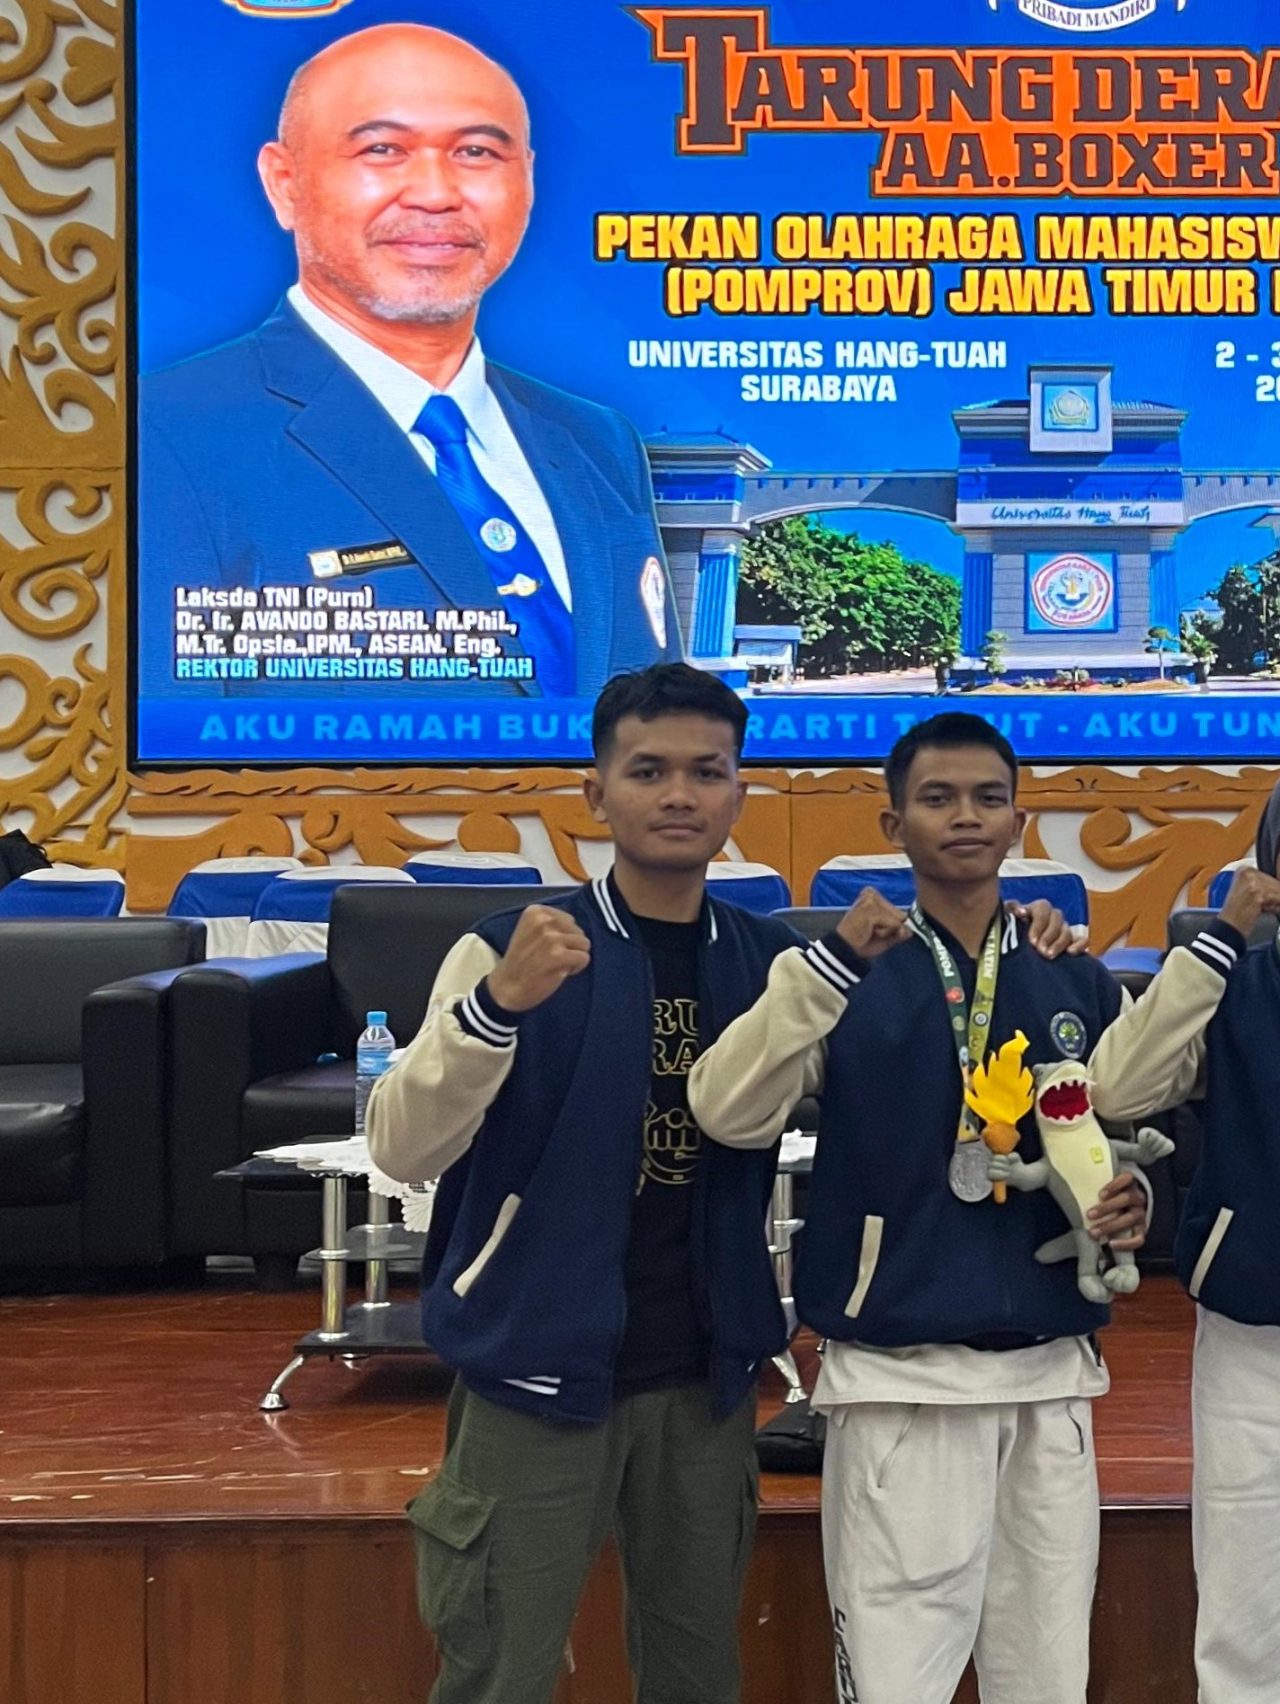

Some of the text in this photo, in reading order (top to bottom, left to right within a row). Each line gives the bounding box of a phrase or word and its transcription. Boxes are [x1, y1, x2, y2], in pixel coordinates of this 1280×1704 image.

[1023, 0, 1081, 27] PRIBADI
[658, 12, 1056, 148] TARUNG
[882, 131, 1275, 189] AA.BOXER
[598, 215, 757, 259] PEKAN
[776, 216, 1022, 259] OLAHRAGA
[667, 267, 931, 315] (POMPROV)
[949, 269, 1091, 313] JAWA
[1106, 269, 1255, 313] TIMUR
[629, 340, 1006, 368] UNIVERSITAS HANG-TUAH
[1216, 341, 1235, 368] 2
[741, 375, 896, 402] SURABAYA
[176, 586, 373, 608] Laksda TNI (Purn)
[176, 610, 206, 631] Dr.
[212, 610, 235, 631] Ir.
[240, 610, 328, 631] AVANDO
[176, 633, 227, 655] M.Tr.
[454, 633, 501, 658] Eng.
[176, 657, 533, 678] REKTOR UNIVERSITAS HANG-TUAH
[200, 714, 295, 740] AKU
[314, 714, 481, 740] RAMAH
[499, 713, 594, 740] BUK
[748, 714, 876, 739] RARTI
[893, 712, 1042, 738] TUT
[1084, 712, 1177, 737] AKU
